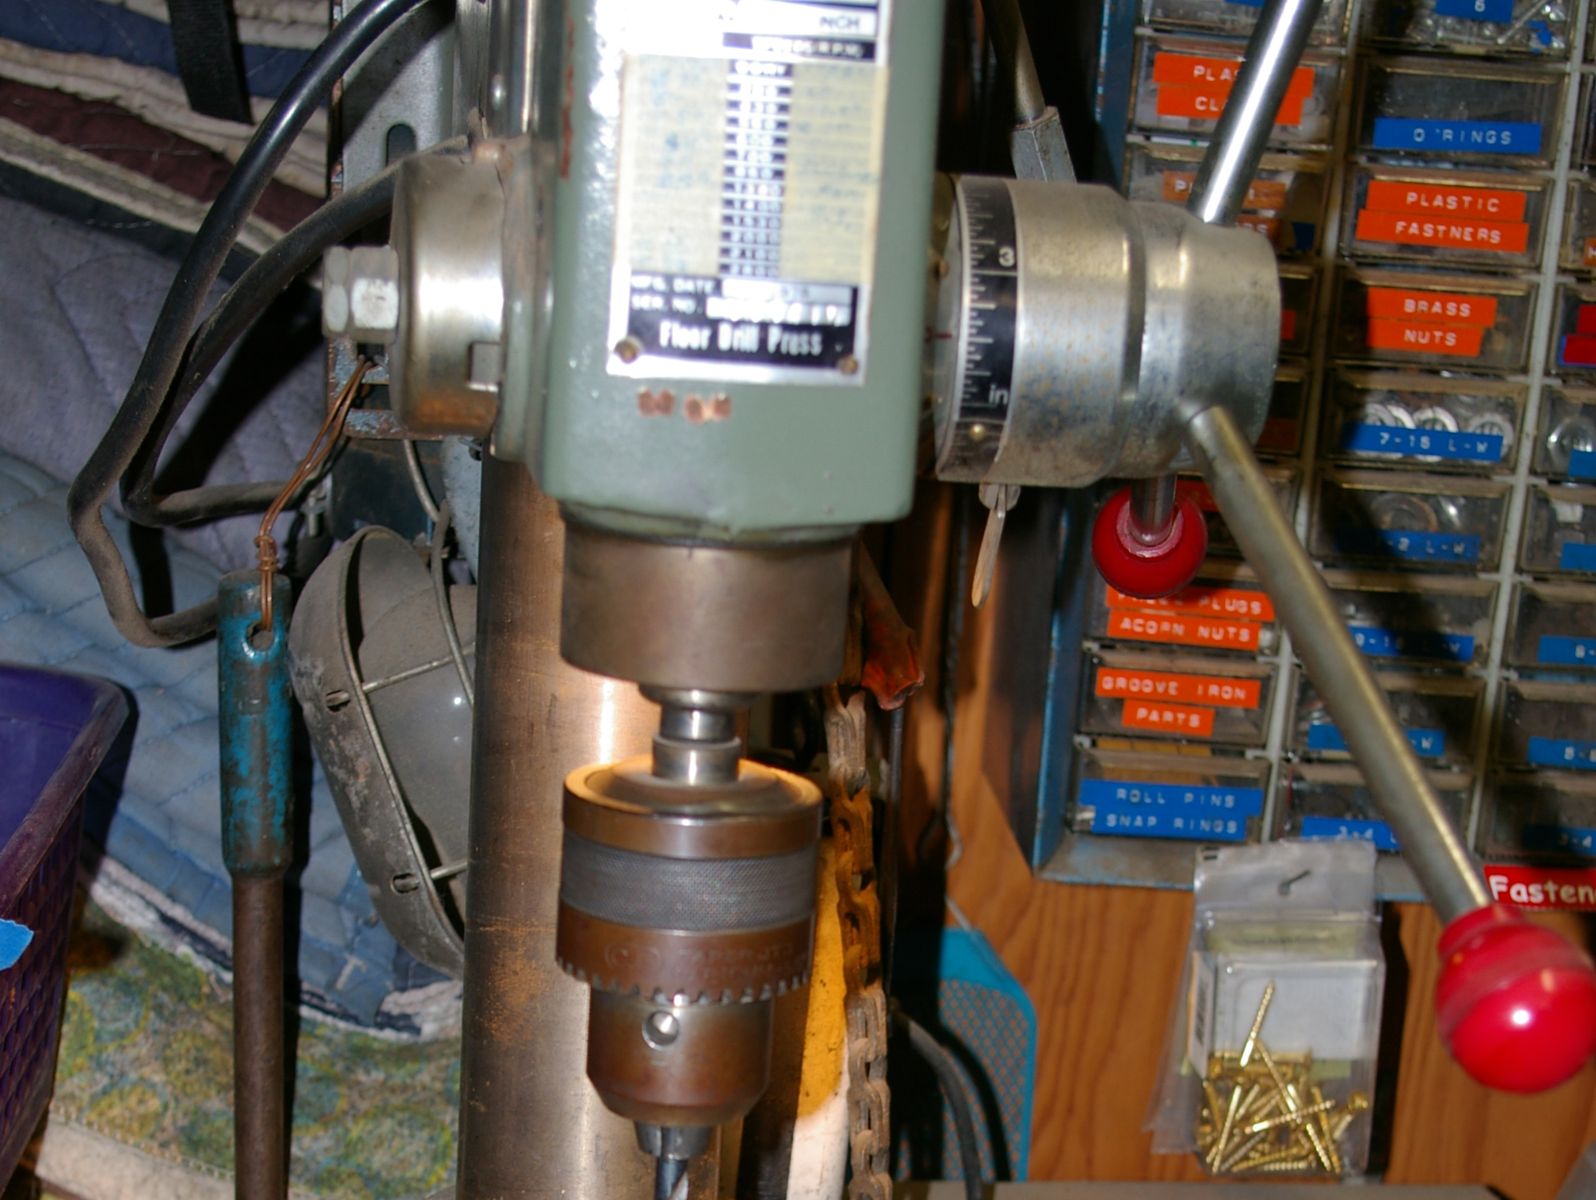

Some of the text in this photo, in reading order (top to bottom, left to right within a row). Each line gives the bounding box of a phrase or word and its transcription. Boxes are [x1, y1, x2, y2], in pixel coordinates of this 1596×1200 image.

[1442, 128, 1512, 145] RINGS
[1406, 192, 1500, 212] PLASTIC
[1395, 221, 1502, 243] FASTNERS
[999, 246, 1015, 267] 3
[1404, 298, 1471, 317] BRASS
[767, 324, 822, 355] Press
[1404, 329, 1457, 346] NUTS
[988, 384, 1009, 405] in
[1200, 596, 1262, 615] PLUGS
[1120, 617, 1250, 642] ACORN NUTS
[1102, 676, 1247, 700] GROOVE IRON
[1136, 708, 1200, 727] PARTS
[1116, 788, 1235, 809] ROLL PINS
[1106, 814, 1238, 834] SNAP RINGS
[1489, 874, 1596, 904] Fasten
